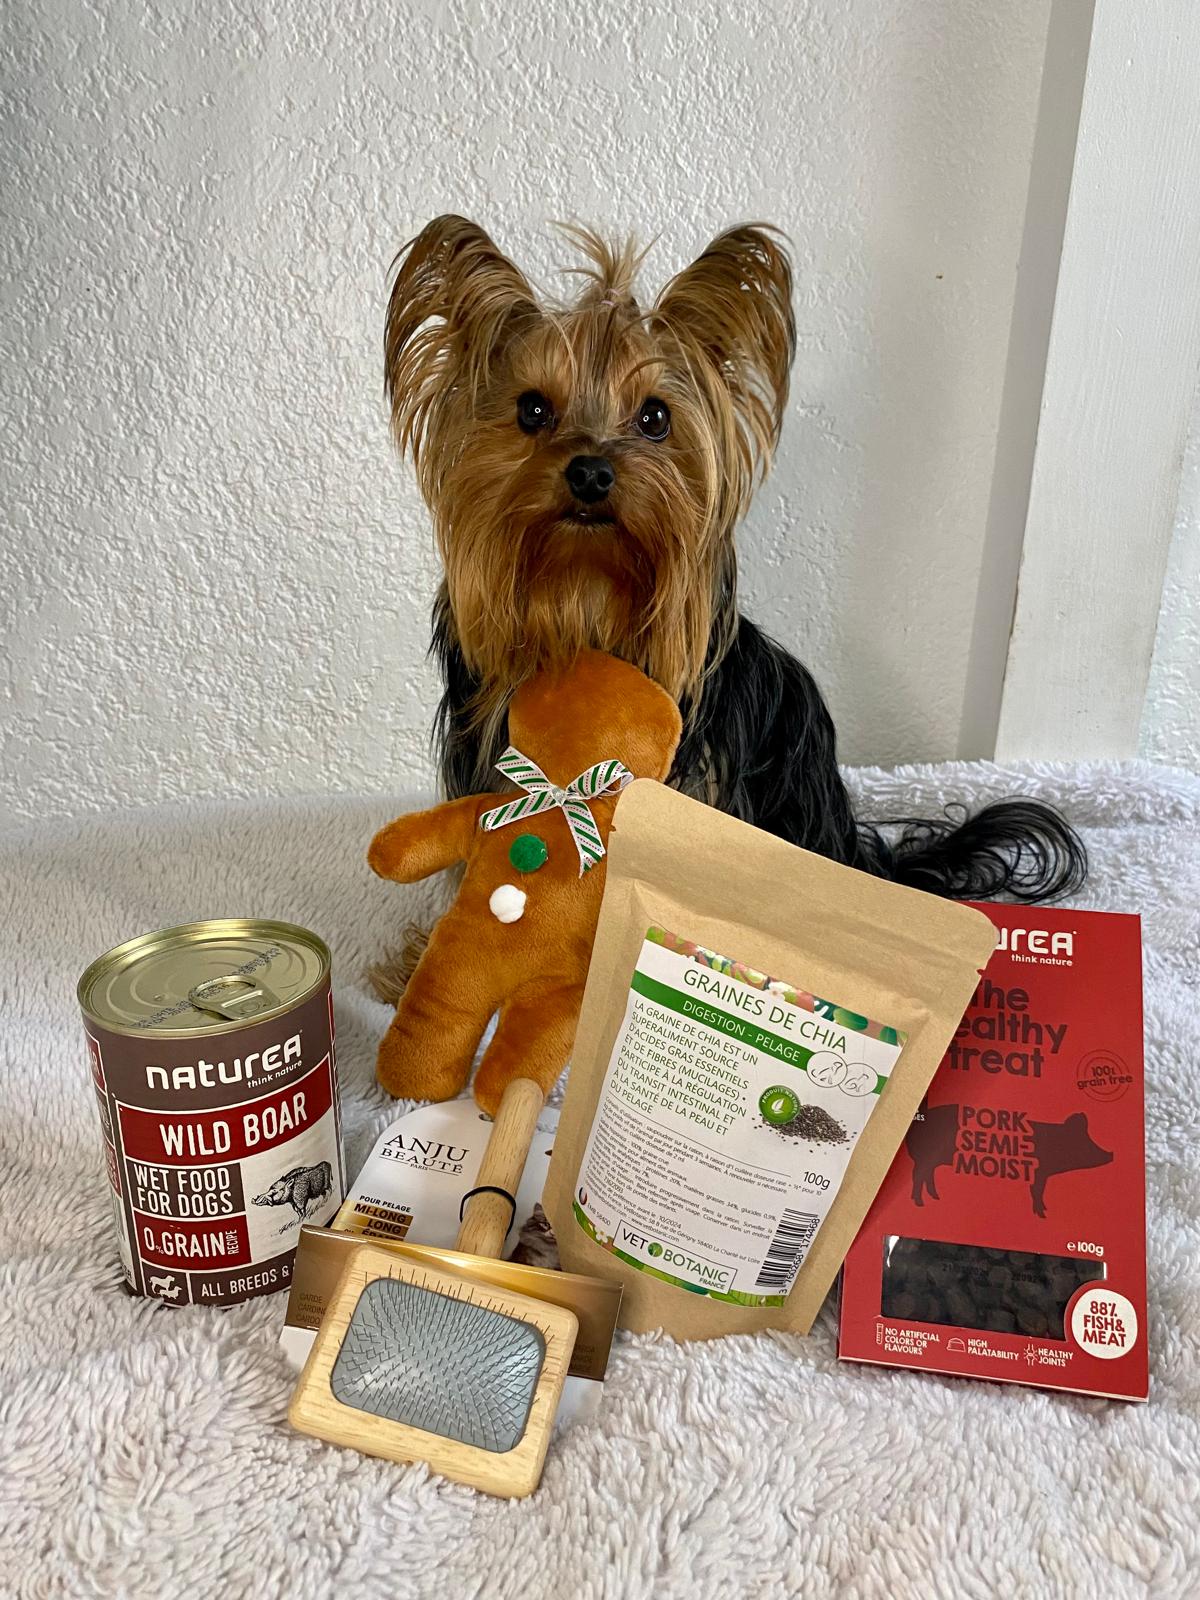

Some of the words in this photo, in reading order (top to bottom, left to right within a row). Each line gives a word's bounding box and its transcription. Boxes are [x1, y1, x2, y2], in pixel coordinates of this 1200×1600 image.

[1011, 954, 1037, 963] think
[1040, 956, 1073, 966] nature
[680, 966, 767, 1017] GRAINES
[767, 1006, 797, 1030] DE
[797, 1018, 851, 1054] CHIA
[627, 1011, 700, 1052] SUPERALIMENT
[697, 1045, 740, 1071] SOURCE
[633, 999, 646, 1012] LA
[644, 1006, 682, 1029] GRAINE
[681, 1023, 696, 1035] DE
[695, 1030, 723, 1048] CHIA
[722, 1042, 741, 1057] EST
[740, 1050, 759, 1065] UN
[681, 999, 747, 1036] DIGESTION
[753, 1032, 801, 1062] PELAGE
[956, 1012, 1067, 1054] ealthy
[623, 1034, 634, 1045] ET
[632, 1040, 647, 1053] DE
[645, 1048, 679, 1070] FIBRES
[676, 1064, 742, 1100] (MUCILAGES)
[625, 1022, 673, 1052] D'ACIDES
[670, 1046, 695, 1064] GRAS
[692, 1057, 750, 1089] ESSENTIELS
[949, 1041, 1044, 1077] treat
[247, 1074, 273, 1088] think
[275, 1060, 302, 1079] nature
[617, 1045, 664, 1076] PARTICIPE
[661, 1068, 671, 1080] À
[670, 1074, 684, 1087] LA
[682, 1079, 749, 1117] RÉGULATION
[1077, 1075, 1107, 1089] grain
[1109, 1074, 1133, 1086] free
[608, 1079, 623, 1093] DU
[618, 1089, 655, 1114] PELAGE
[613, 1068, 621, 1078] À
[619, 1075, 630, 1085] LA
[628, 1079, 661, 1104] SANTÉ
[659, 1095, 674, 1109] DE
[673, 1103, 689, 1116] LA
[687, 1110, 715, 1129] PEAU
[715, 1123, 728, 1136] ET
[615, 1057, 630, 1070] DU
[626, 1066, 668, 1092] TRANSIT
[665, 1086, 723, 1119] INTESTINAL
[722, 1113, 736, 1125] ET
[760, 1086, 788, 1104] PRODUIT
[159, 1121, 231, 1156] WILD
[243, 1091, 307, 1146] BOAR
[962, 1106, 1027, 1133] PORK
[385, 1134, 470, 1162] ANJU
[645, 1139, 666, 1153] doseuse
[961, 1130, 1029, 1155] SEMI-
[381, 1148, 463, 1174] BEAUTÉ
[627, 1146, 640, 1157] pour
[639, 1153, 658, 1166] aliment
[656, 1163, 666, 1171] des
[666, 1167, 687, 1182] animaux
[631, 1164, 641, 1173] eau
[641, 1148, 658, 1160] graine
[657, 1156, 669, 1166] crue
[645, 1123, 674, 1143] saupoudrer
[709, 1155, 725, 1166] raison
[734, 1165, 753, 1176] cuillère
[753, 1171, 775, 1184] doseuse
[801, 1186, 814, 1194] pour
[652, 1136, 662, 1145] par
[661, 1141, 673, 1150] jour
[672, 1145, 694, 1160] pendant
[728, 1170, 755, 1185] renouveler
[761, 1180, 787, 1196] nécessaire
[955, 1154, 1033, 1181] MOIST
[133, 1163, 169, 1192] WET
[177, 1167, 230, 1193] FOOD
[614, 1177, 627, 1187] hors
[631, 1187, 649, 1200] portée
[648, 1195, 659, 1204] des
[645, 1163, 669, 1180] protéines
[682, 1183, 705, 1196] matières
[705, 1193, 725, 1205] grasses
[740, 1205, 761, 1218] glucides
[801, 1170, 831, 1191] 100g
[137, 1188, 172, 1215] FOR
[179, 1191, 233, 1216] DOGS
[354, 1204, 406, 1223] MI-LONG
[360, 1195, 381, 1206] POUR
[382, 1201, 411, 1212] PELAGE
[633, 1173, 658, 1190] introduire
[659, 1185, 700, 1210] progressivement
[701, 1206, 714, 1215] dans
[742, 1220, 765, 1231] Surveiller
[636, 1180, 648, 1191] Bien
[647, 1187, 670, 1202] refermer
[669, 1198, 684, 1209] après
[702, 1213, 728, 1227] Conserver
[729, 1223, 742, 1231] dans
[751, 1230, 770, 1240] endroit
[367, 1219, 400, 1234] LONG
[636, 1204, 651, 1215] avant
[658, 1214, 682, 1230] 10/2024
[227, 1230, 238, 1255] RECIPE
[659, 1222, 669, 1230] rue
[668, 1226, 676, 1234] de
[696, 1239, 713, 1249] 58400
[720, 1247, 738, 1258] Charité
[747, 1256, 760, 1264] Loire
[801, 1217, 820, 1249] 174468
[619, 1228, 648, 1250] VET
[661, 1248, 730, 1283] BOTANIC
[1077, 1241, 1104, 1256] 100g
[201, 1283, 224, 1297] ALL
[230, 1269, 277, 1294] BREEDS
[282, 1265, 289, 1277] &
[786, 1253, 804, 1283] 760268
[699, 1277, 725, 1290] FRANCE
[1089, 1301, 1117, 1317] 88%
[885, 1328, 897, 1336] NO
[900, 1330, 940, 1342] ARTIFICIAL
[1083, 1314, 1126, 1333] FISH&
[884, 1343, 923, 1355] FLAVOURS
[885, 1336, 915, 1346] COLORS
[916, 1340, 927, 1348] OR
[968, 1339, 988, 1347] HIGH
[1083, 1331, 1126, 1348] MEAT
[968, 1347, 1019, 1361] PALATABILITY
[1038, 1348, 1073, 1360] HEALTHY
[1038, 1356, 1066, 1367] JOINTS
